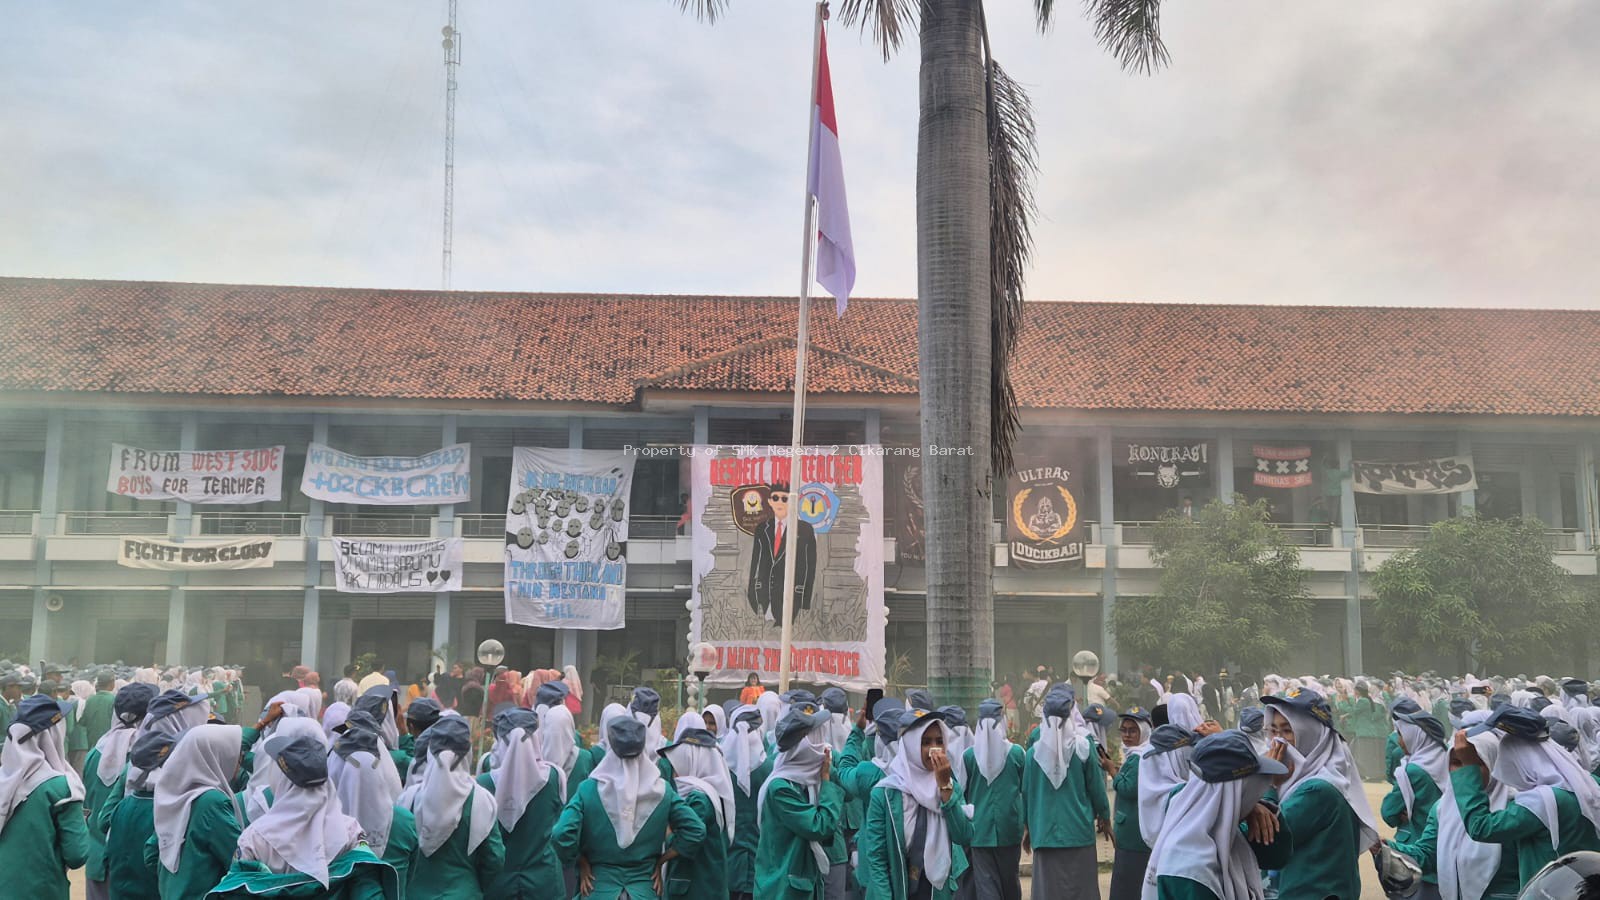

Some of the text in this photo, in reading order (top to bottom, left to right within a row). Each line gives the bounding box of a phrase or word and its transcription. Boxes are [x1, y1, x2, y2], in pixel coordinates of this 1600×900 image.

[120, 447, 280, 472] FROM WEST SIDE
[710, 455, 863, 487] RESPECT TH TEACHER
[1017, 466, 1071, 483] ULTRAS
[117, 475, 265, 495] BOYS FOR TEACHER
[181, 547, 217, 562] FOR
[1016, 543, 1078, 560] DUCIKBAR
[726, 646, 760, 670] MAKE
